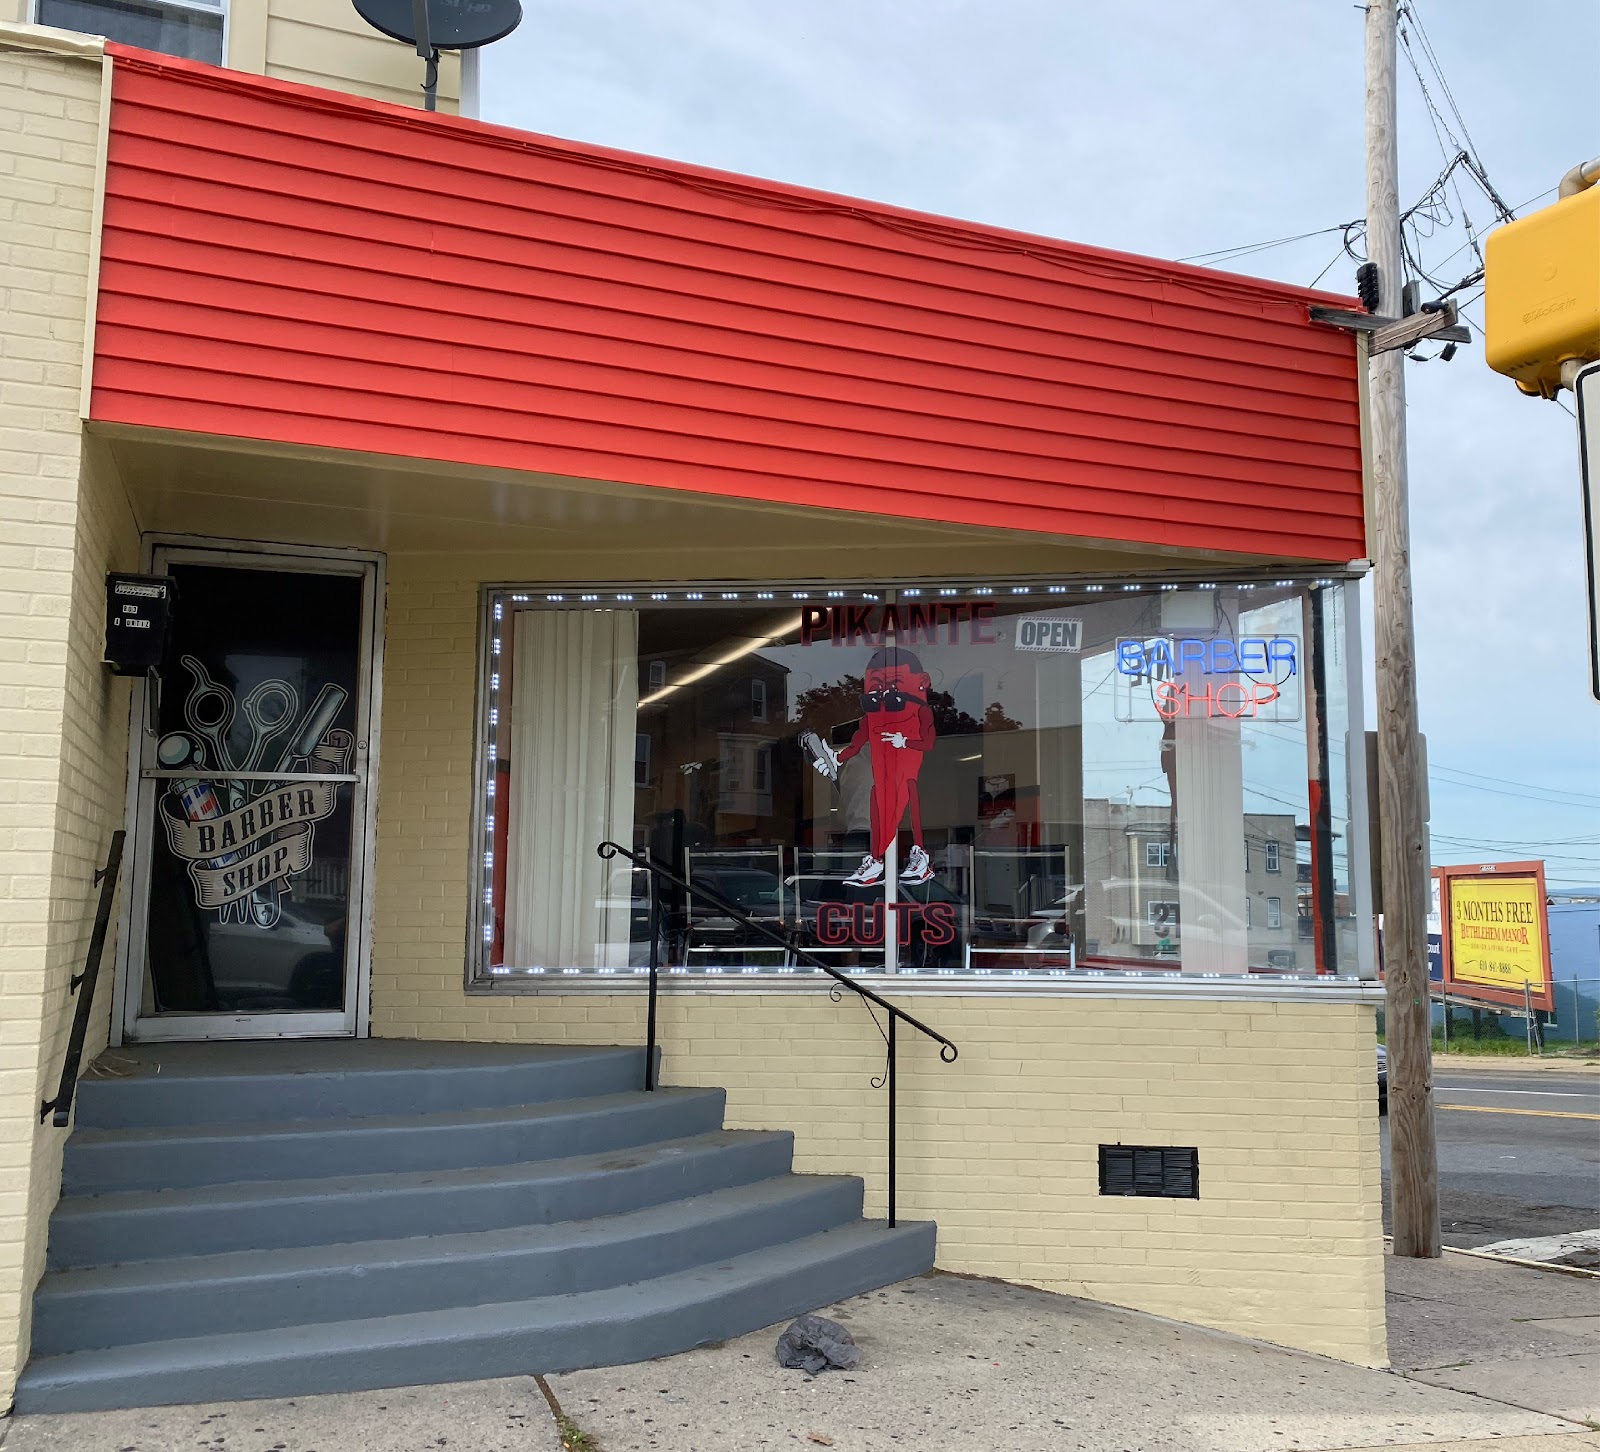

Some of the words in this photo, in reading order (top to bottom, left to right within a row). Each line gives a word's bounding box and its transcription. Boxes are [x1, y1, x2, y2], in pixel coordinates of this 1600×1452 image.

[801, 602, 996, 647] PIKANTE
[1020, 621, 1078, 648] OPEN
[1117, 639, 1296, 675] BARBER
[1155, 682, 1281, 718] SHOP
[197, 788, 316, 853] BARBER
[223, 846, 288, 897] SHOP
[816, 902, 955, 945] CUTS
[1456, 901, 1461, 920] 3
[1463, 901, 1503, 923] MONTHS
[1506, 902, 1533, 924] FREE
[1461, 922, 1501, 941] BETHLEHEM
[1501, 926, 1528, 945] MANOR
